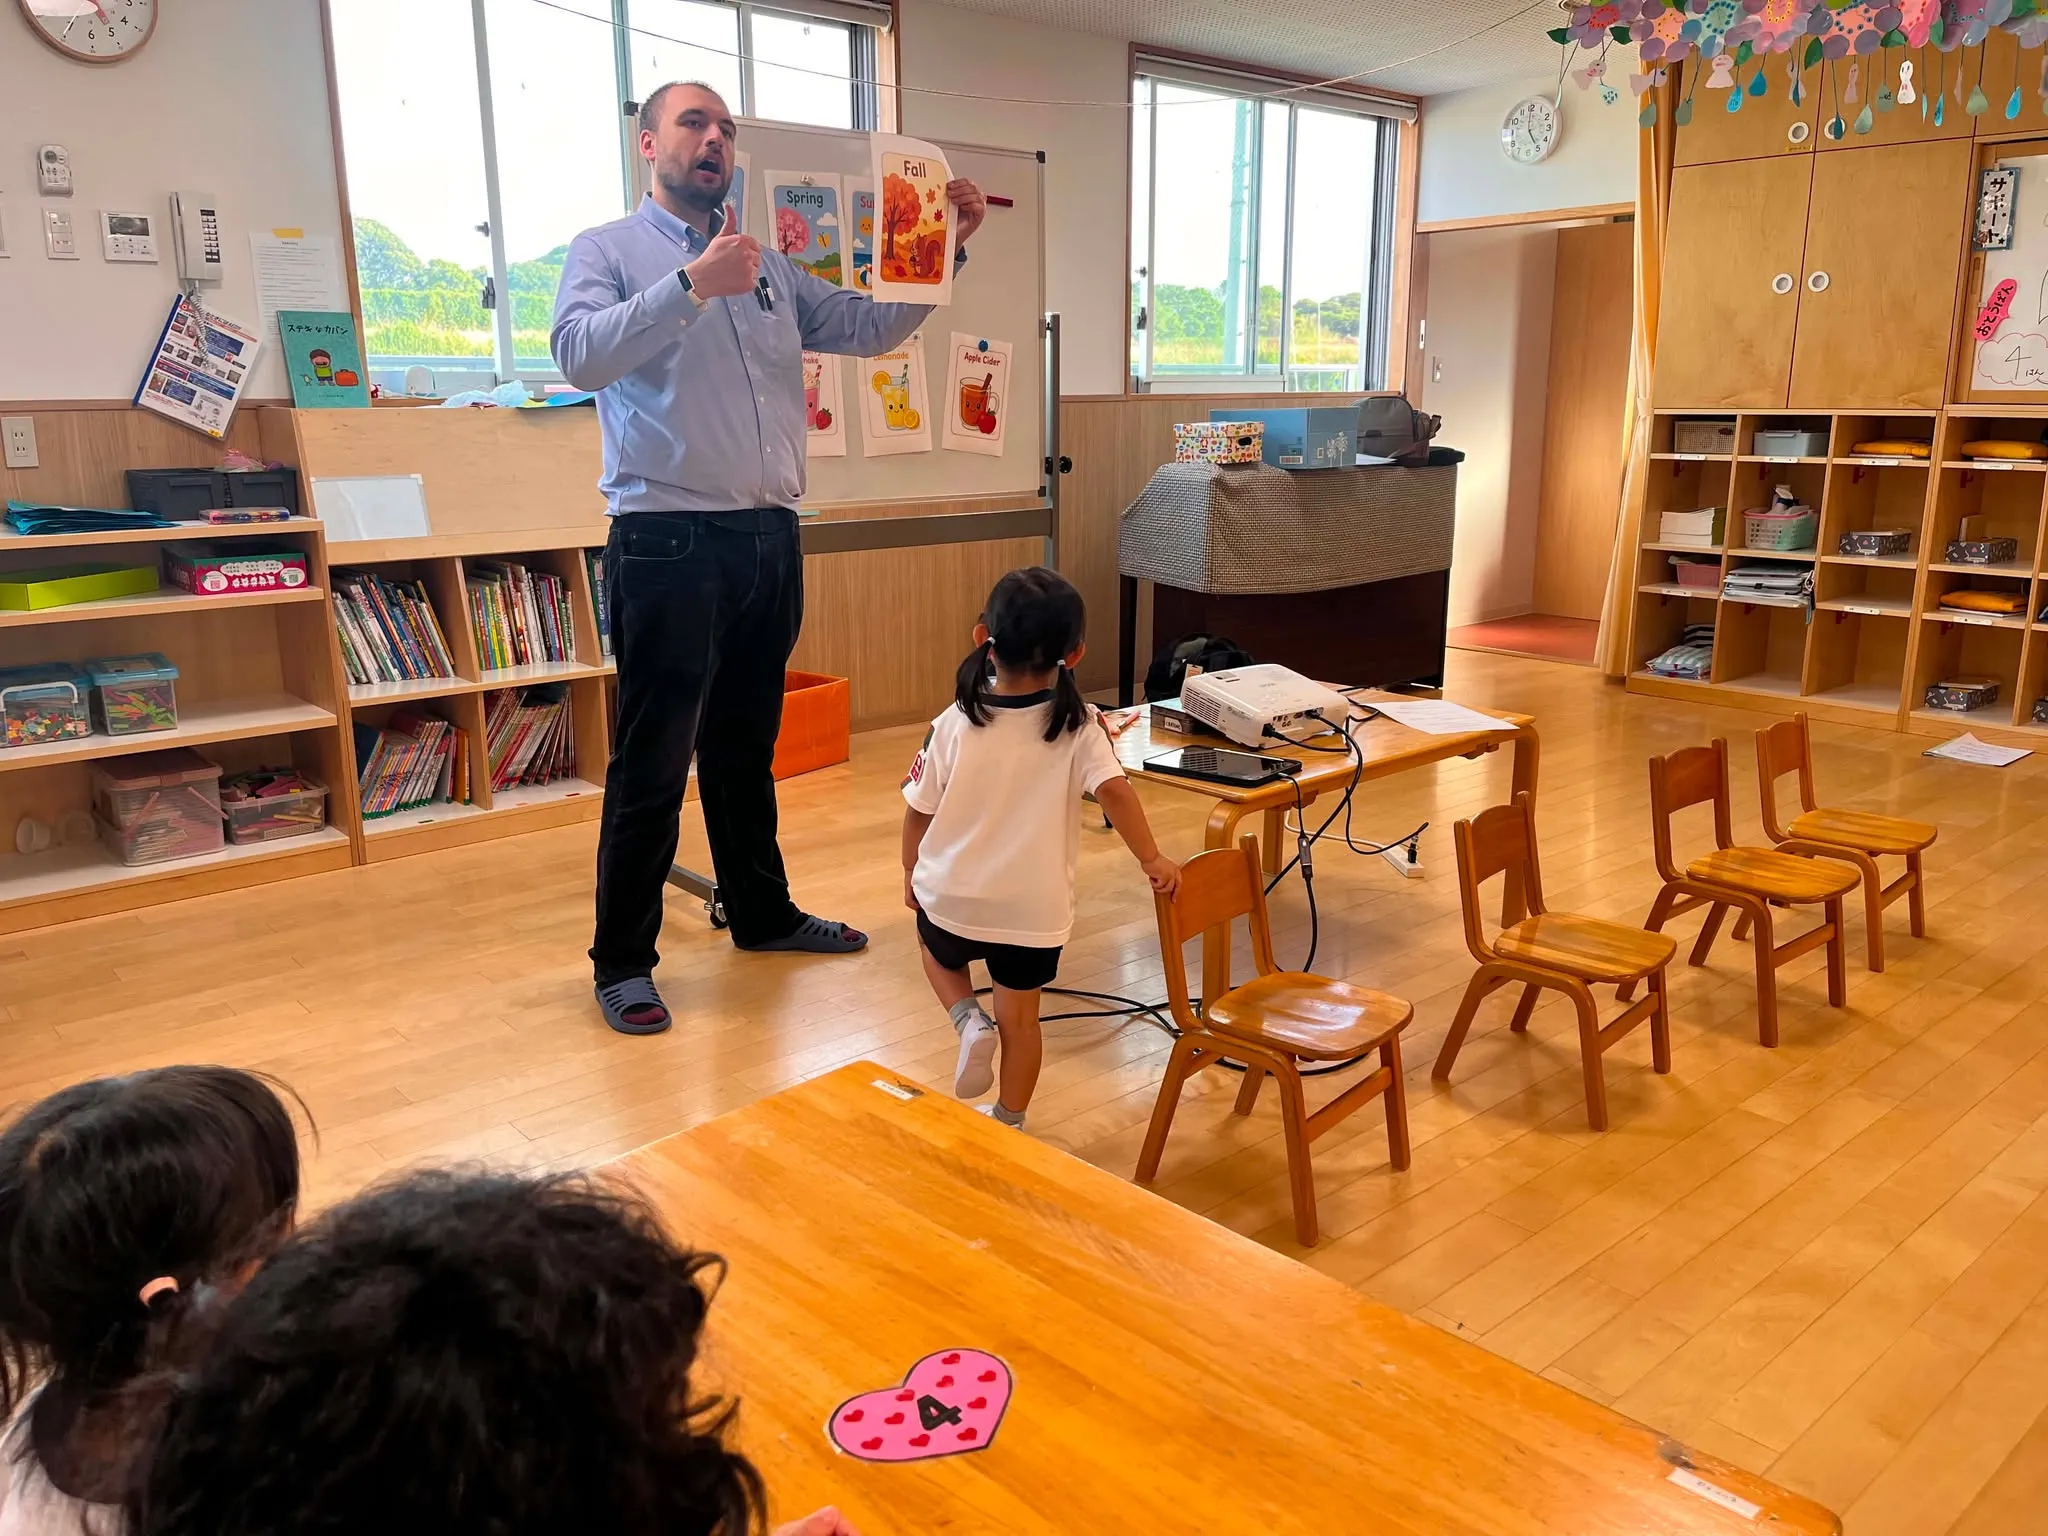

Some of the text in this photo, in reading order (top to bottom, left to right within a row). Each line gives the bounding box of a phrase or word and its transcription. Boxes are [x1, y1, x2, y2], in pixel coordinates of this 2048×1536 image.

[120, 16, 129, 25] 4
[88, 29, 95, 40] 6
[108, 27, 115, 37] 5
[1528, 104, 1535, 112] 12
[1544, 113, 1550, 121] 2
[903, 160, 927, 178] Fall
[786, 190, 824, 208] Spring
[1976, 286, 2014, 336] おとうばん
[964, 352, 1000, 366] Apple Cider
[2005, 345, 2032, 380] 4
[916, 1394, 963, 1431] 4
